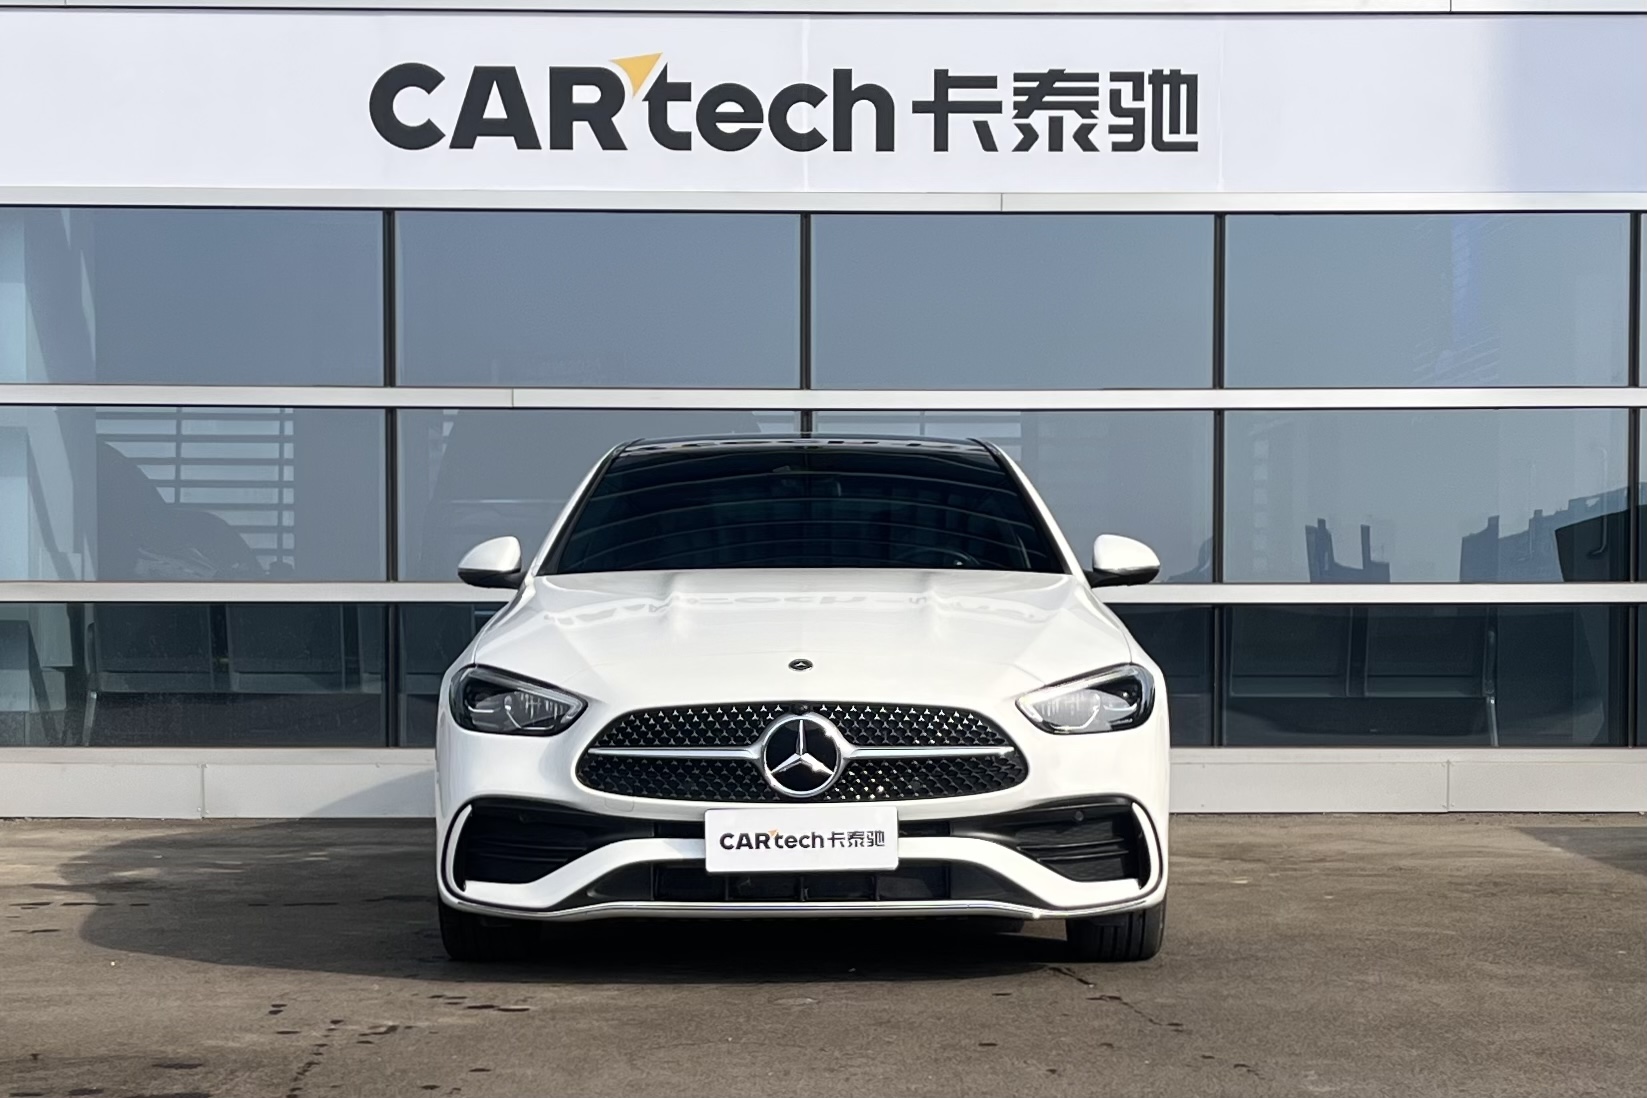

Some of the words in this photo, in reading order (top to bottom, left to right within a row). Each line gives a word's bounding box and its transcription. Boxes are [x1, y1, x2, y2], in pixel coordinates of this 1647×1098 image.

[368, 60, 895, 153] CARtech
[911, 68, 1199, 153] 卡泰驰
[719, 831, 825, 851] CARtech
[827, 830, 885, 849] 卡泰驰
